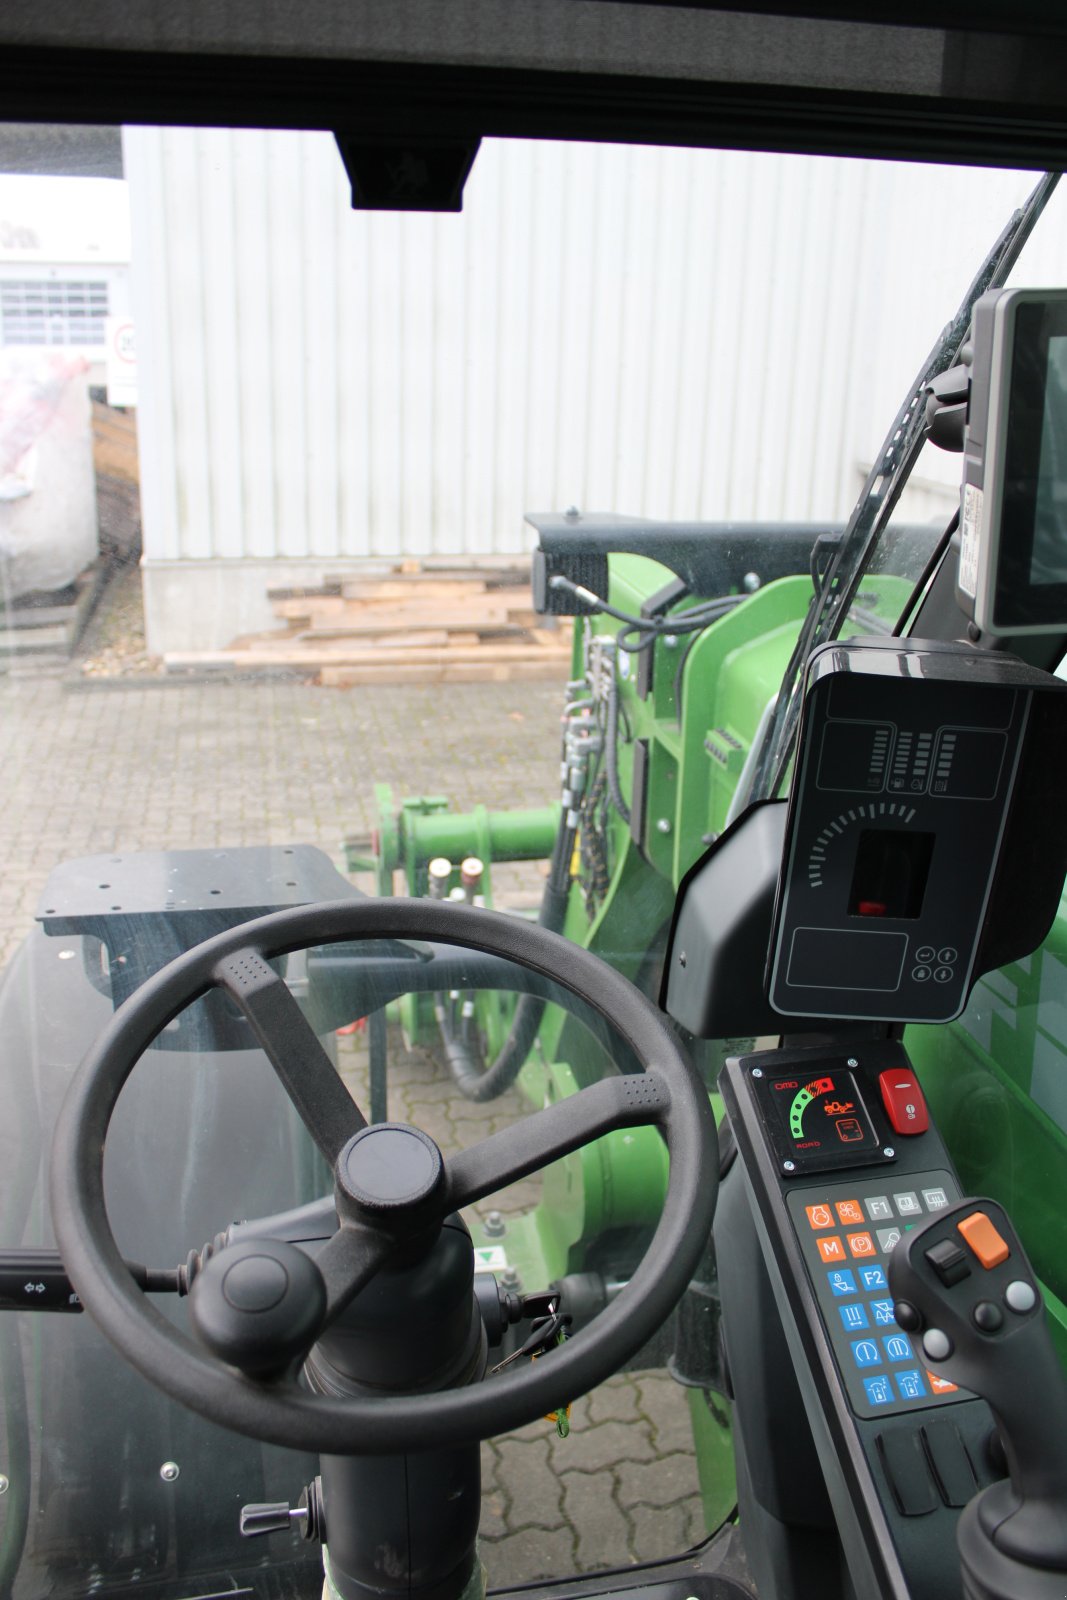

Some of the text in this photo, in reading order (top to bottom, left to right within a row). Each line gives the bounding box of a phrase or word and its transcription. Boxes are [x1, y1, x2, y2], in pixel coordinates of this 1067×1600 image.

[871, 1201, 888, 1215] F1
[823, 1241, 839, 1256] M
[864, 1270, 884, 1285] F2
